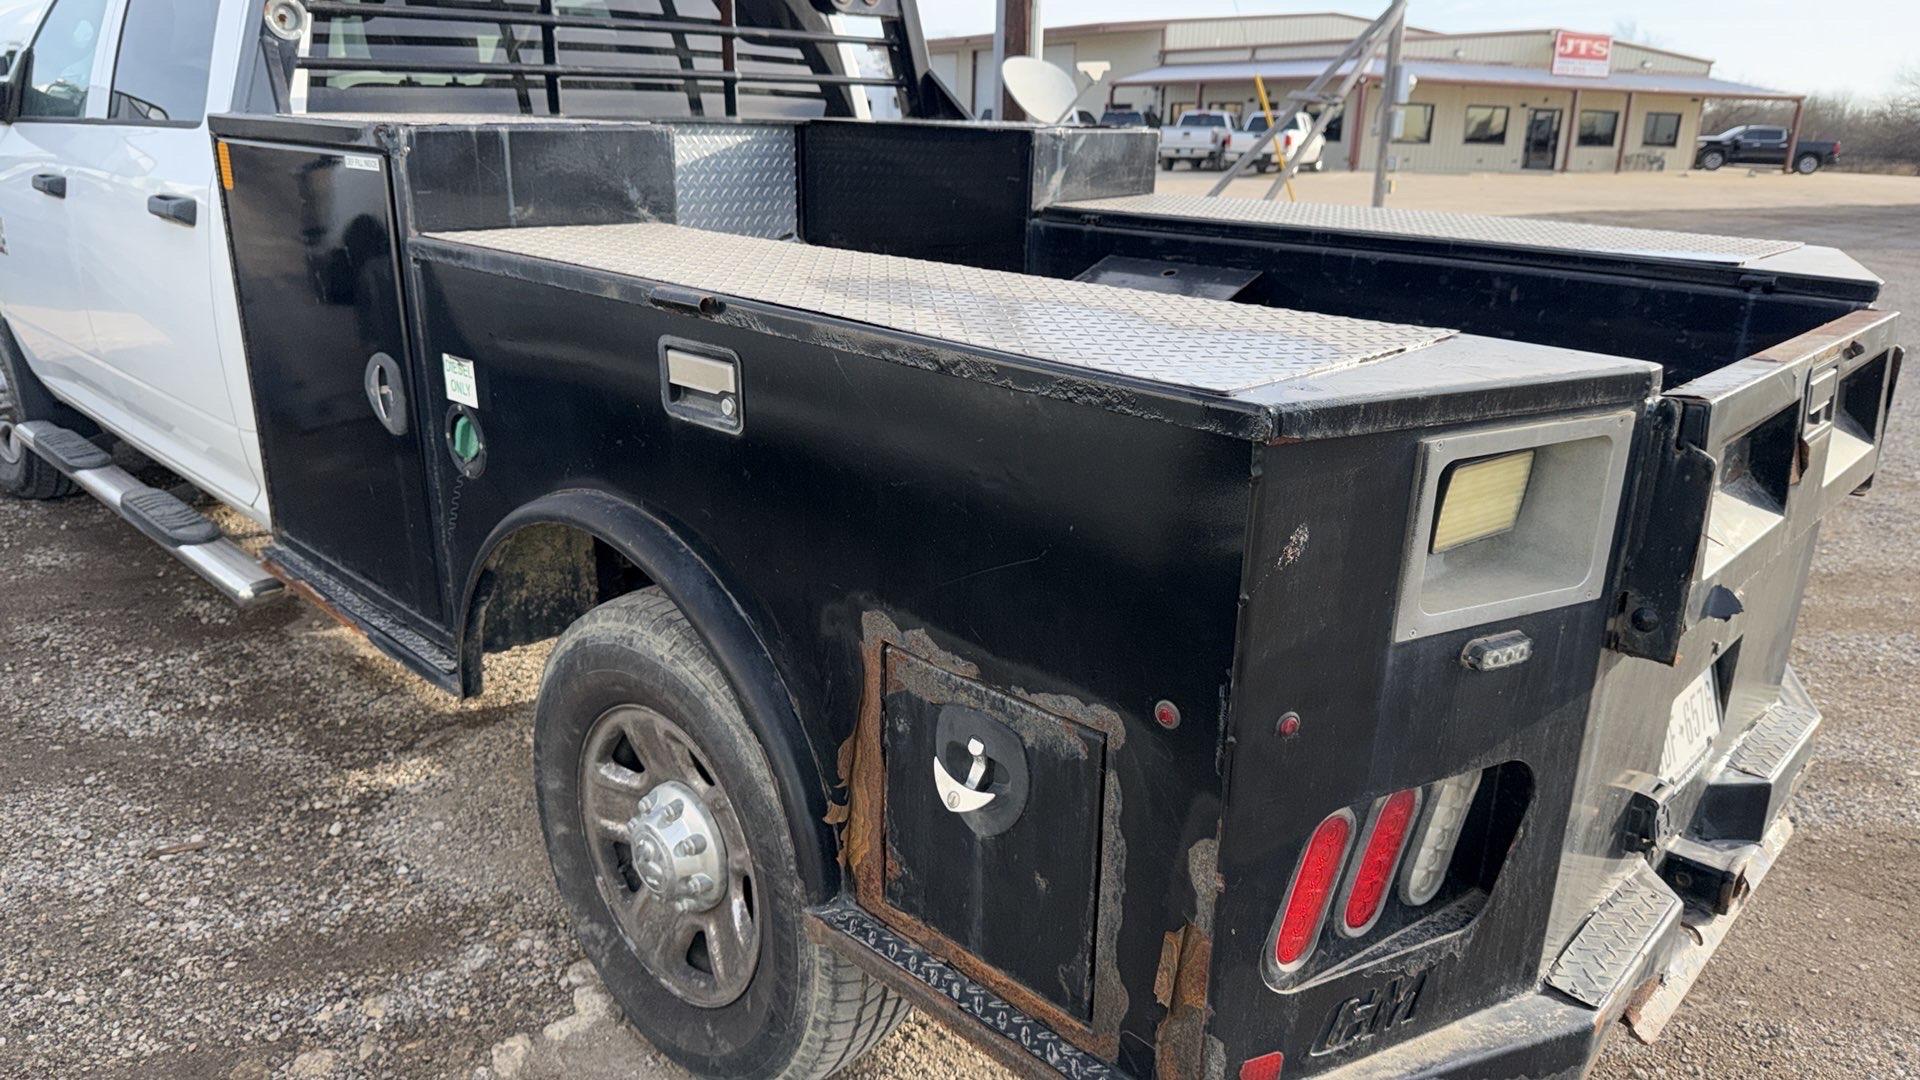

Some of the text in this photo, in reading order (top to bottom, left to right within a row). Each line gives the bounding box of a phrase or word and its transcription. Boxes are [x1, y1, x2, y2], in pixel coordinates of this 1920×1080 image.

[1560, 38, 1608, 57] JTS
[445, 359, 472, 379] DIESEL
[451, 379, 471, 397] ONLY
